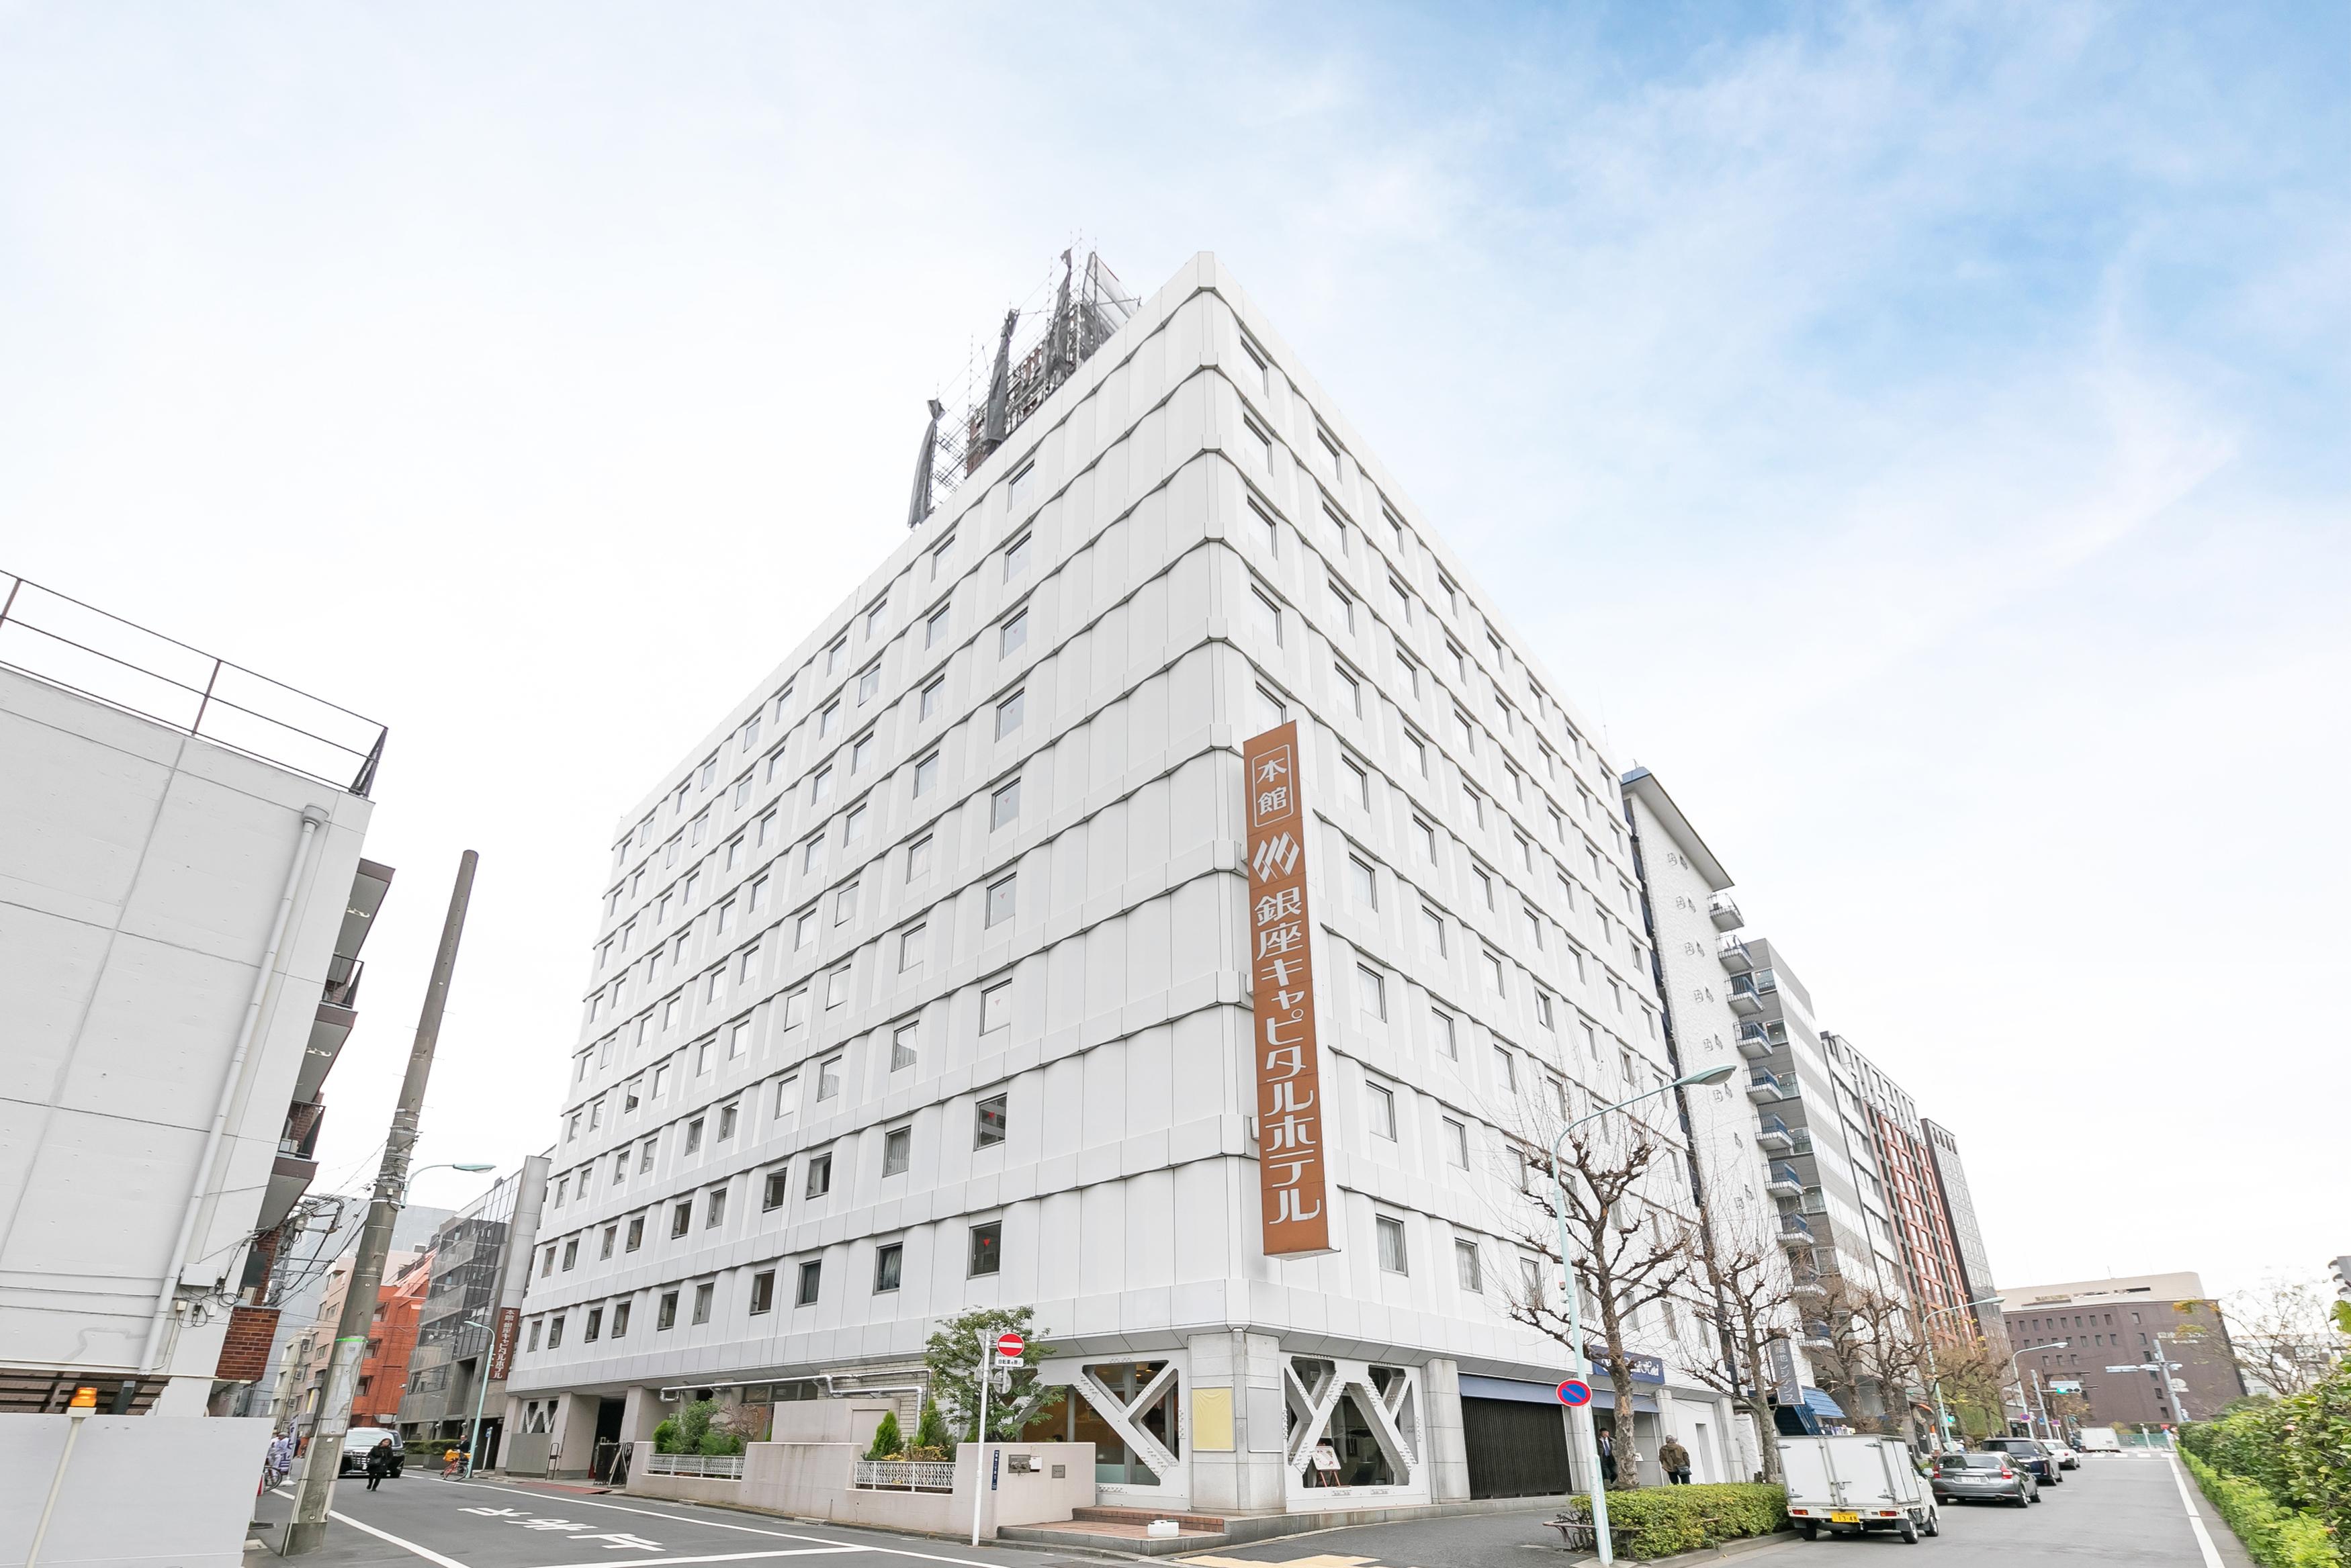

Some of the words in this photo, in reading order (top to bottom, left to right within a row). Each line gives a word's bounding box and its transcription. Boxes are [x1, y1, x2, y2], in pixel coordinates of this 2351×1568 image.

[1256, 756, 1288, 816] 本館
[1254, 886, 1321, 1226] 銀座キャピタルホテル
